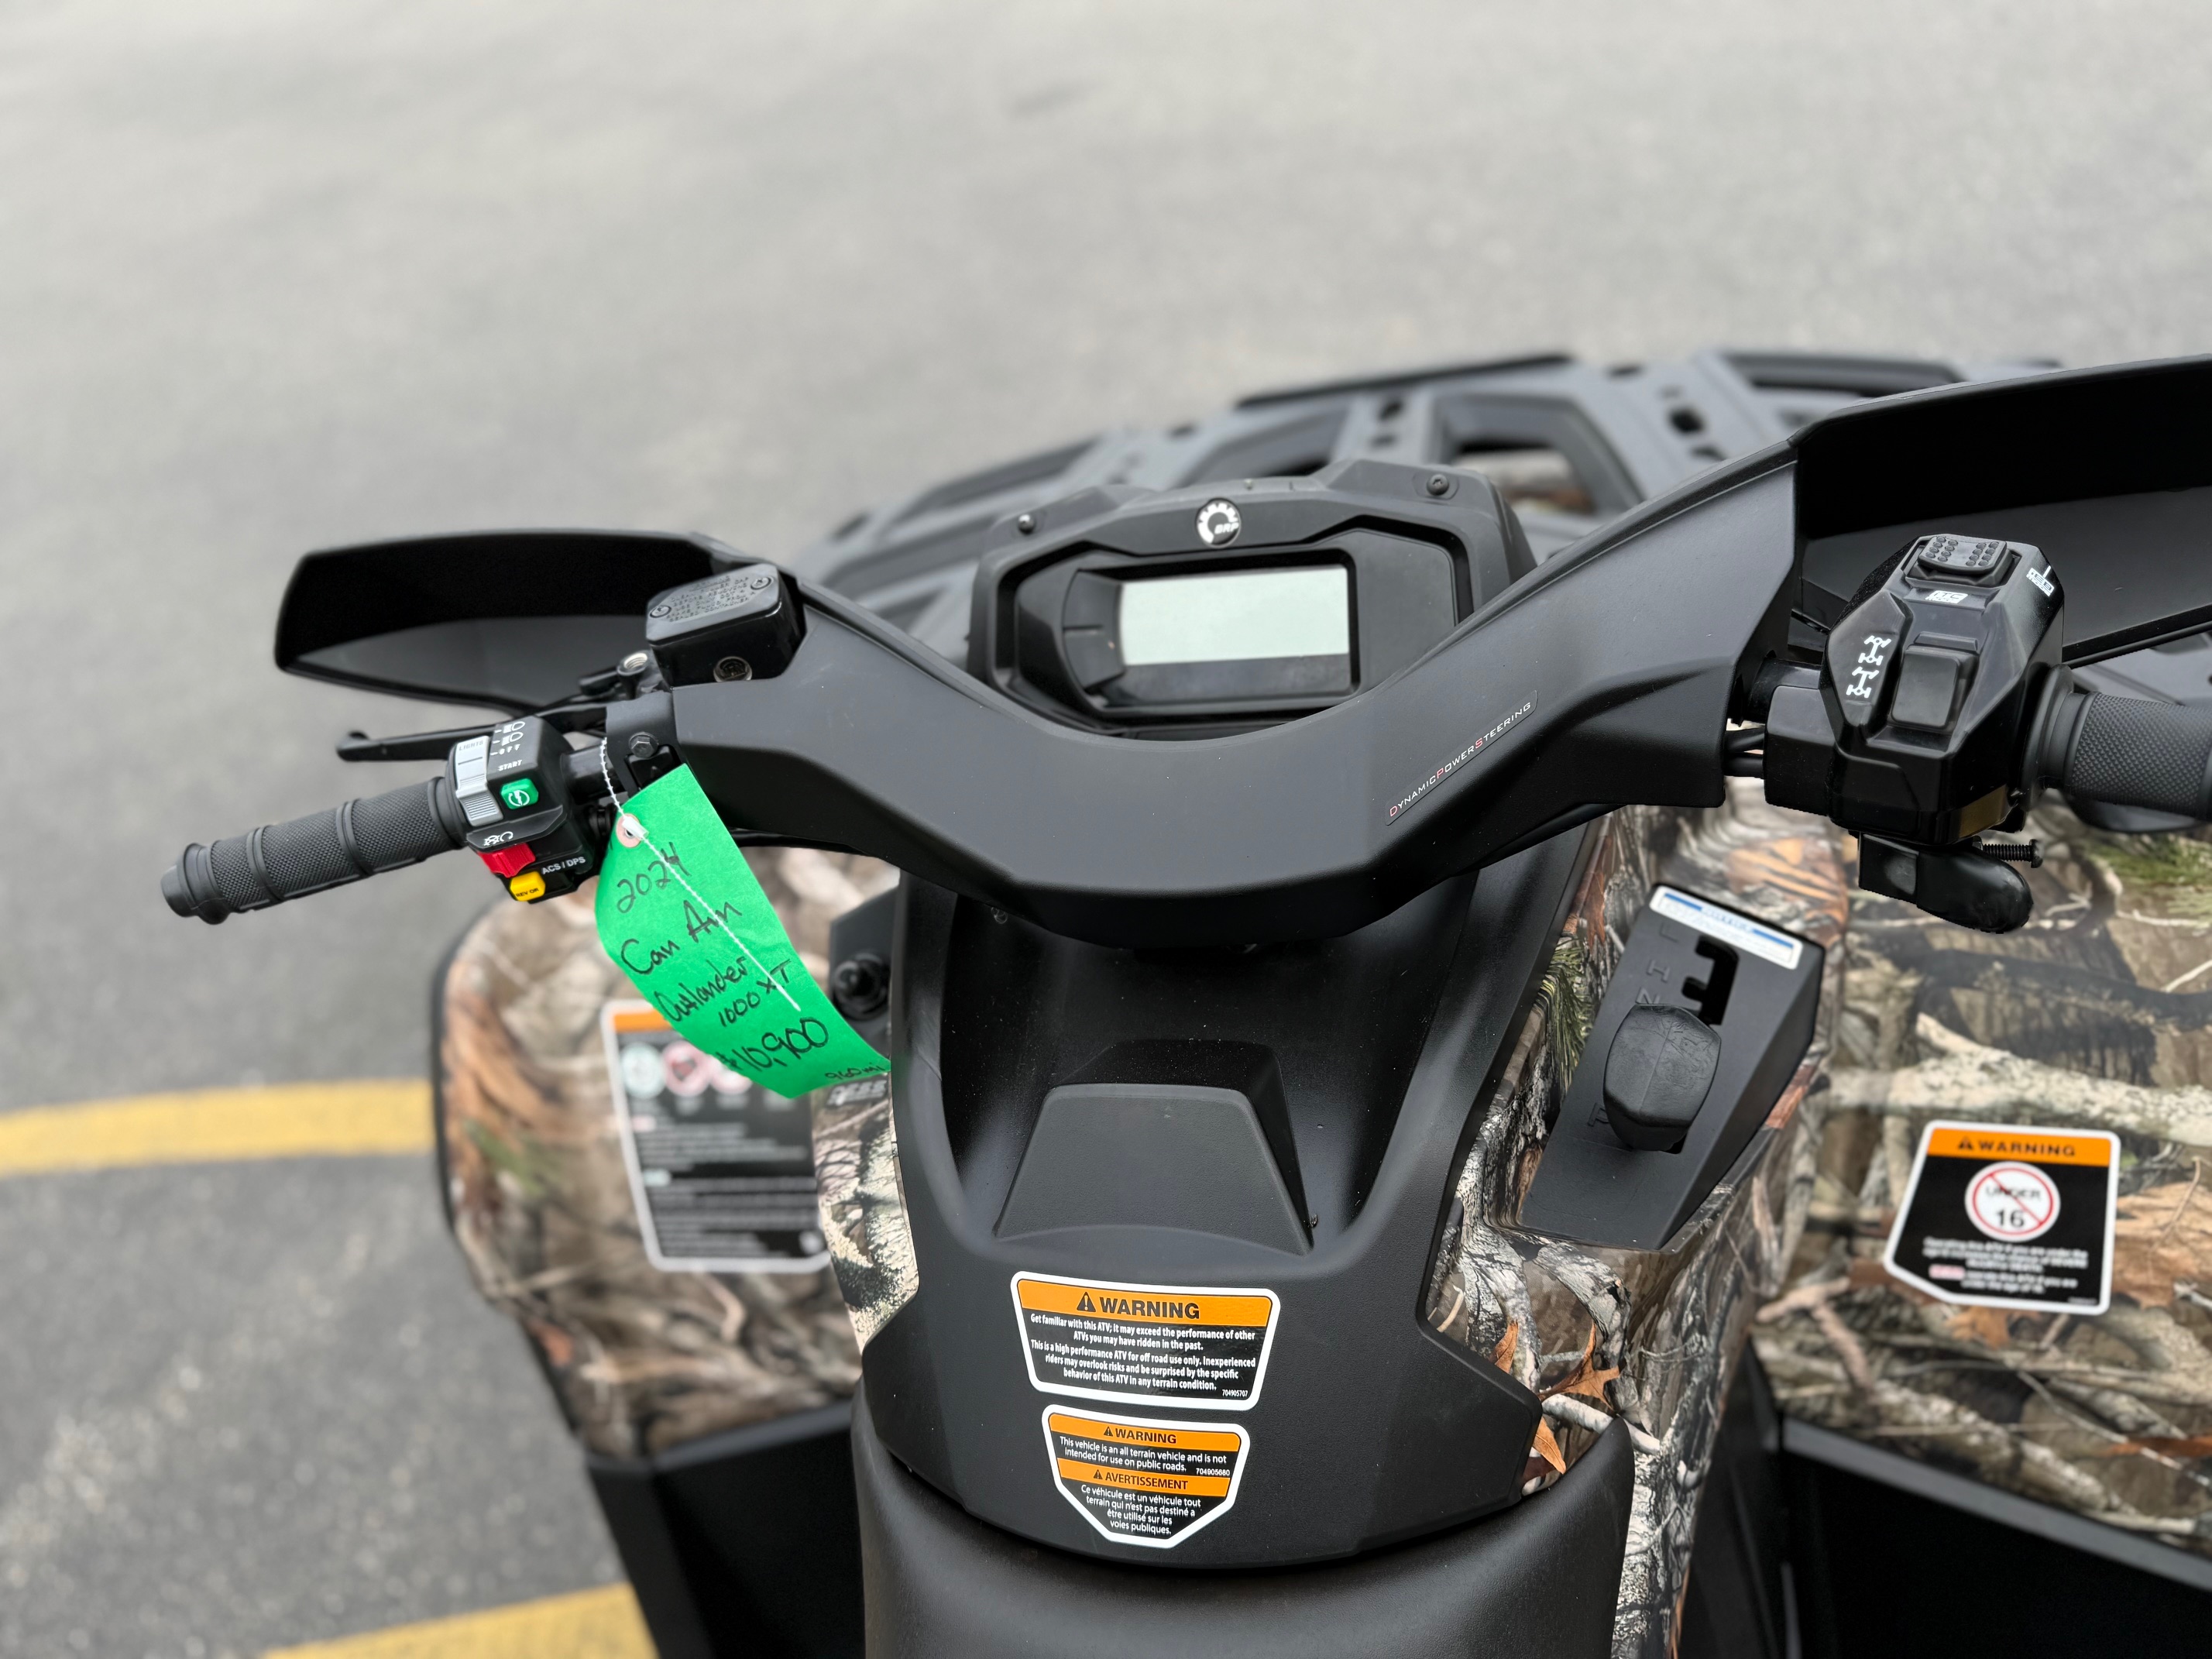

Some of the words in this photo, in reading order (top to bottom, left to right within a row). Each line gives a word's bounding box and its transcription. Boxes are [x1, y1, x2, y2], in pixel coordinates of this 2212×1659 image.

[459, 740, 483, 750] LIGHTS
[498, 760, 523, 771] START
[542, 863, 561, 874] ACS
[566, 857, 586, 867] DPS
[617, 842, 692, 913] 2024
[621, 938, 680, 974] Can
[1646, 959, 1671, 984] H
[719, 991, 761, 1027] 1000
[1979, 1140, 2076, 1156] WARNING
[1996, 1208, 2025, 1228] 16
[1100, 1297, 1200, 1319] WARNING
[1031, 1314, 1042, 1323] Get
[1042, 1315, 1066, 1327] familiar
[1068, 1319, 1083, 1329] with
[1084, 1321, 1096, 1330] this
[1097, 1322, 1112, 1333] ATV;
[1120, 1325, 1135, 1336] may
[1136, 1325, 1161, 1336] exceed
[1163, 1328, 1175, 1337] the
[1176, 1328, 1224, 1339] performance
[1225, 1330, 1234, 1339] of
[1235, 1331, 1255, 1340] other
[1073, 1331, 1088, 1341] ATVs
[1090, 1334, 1101, 1344] you
[1103, 1336, 1118, 1346] may
[1119, 1335, 1135, 1346] have
[1137, 1337, 1160, 1348] ridden
[1162, 1339, 1169, 1348] in
[1170, 1340, 1183, 1348] the
[1185, 1341, 1203, 1352] past.
[1031, 1339, 1042, 1349] This
[1055, 1343, 1069, 1355] high
[1070, 1346, 1113, 1358] performance
[1114, 1351, 1127, 1360] ATV
[1128, 1352, 1139, 1361] for
[1140, 1352, 1151, 1362] off
[1152, 1354, 1168, 1363] road
[1183, 1355, 1201, 1367] only.
[1204, 1356, 1255, 1368] Inexperienced
[1046, 1354, 1063, 1365] riders
[1064, 1358, 1077, 1368] may
[1079, 1359, 1108, 1370] overlook
[1109, 1362, 1125, 1372] risks
[1126, 1364, 1139, 1373] and
[1141, 1365, 1149, 1374] be
[1151, 1367, 1185, 1377] surprised
[1187, 1367, 1195, 1379] by
[1197, 1368, 1209, 1377] the
[1211, 1369, 1238, 1380] specific
[1063, 1367, 1091, 1379] behavior
[1093, 1372, 1101, 1380] of
[1101, 1372, 1114, 1382] this
[1115, 1376, 1128, 1384] ATV
[1129, 1376, 1136, 1385] in
[1138, 1378, 1151, 1388] any
[1152, 1378, 1177, 1388] terrain
[1179, 1380, 1216, 1389] condition.
[1115, 1428, 1176, 1444] WARNING
[1060, 1436, 1073, 1447] This
[1075, 1441, 1100, 1451] vehicle
[1101, 1444, 1108, 1452] is
[1130, 1448, 1156, 1459] terrain
[1157, 1451, 1185, 1461] vehicle
[1187, 1453, 1202, 1462] and
[1205, 1454, 1211, 1462] is
[1213, 1455, 1227, 1464] not
[1065, 1448, 1096, 1461] intended
[1098, 1453, 1108, 1462] for
[1137, 1458, 1161, 1469] public
[1163, 1462, 1187, 1472] roads.
[1105, 1472, 1188, 1489] AVERTISSEMENT
[1081, 1485, 1091, 1493] Ce
[1092, 1486, 1122, 1499] véhicule
[1149, 1495, 1181, 1506] véhicule
[1184, 1499, 1200, 1507] tout
[1087, 1496, 1110, 1506] terrain
[1111, 1501, 1123, 1510] qui
[1145, 1505, 1157, 1514] pas
[1159, 1506, 1188, 1516] destiné
[1111, 1520, 1129, 1529] voies
[1131, 1523, 1171, 1535] publiques.
[1124, 1511, 1146, 1522] utilisé
[1162, 1515, 1172, 1525] les
